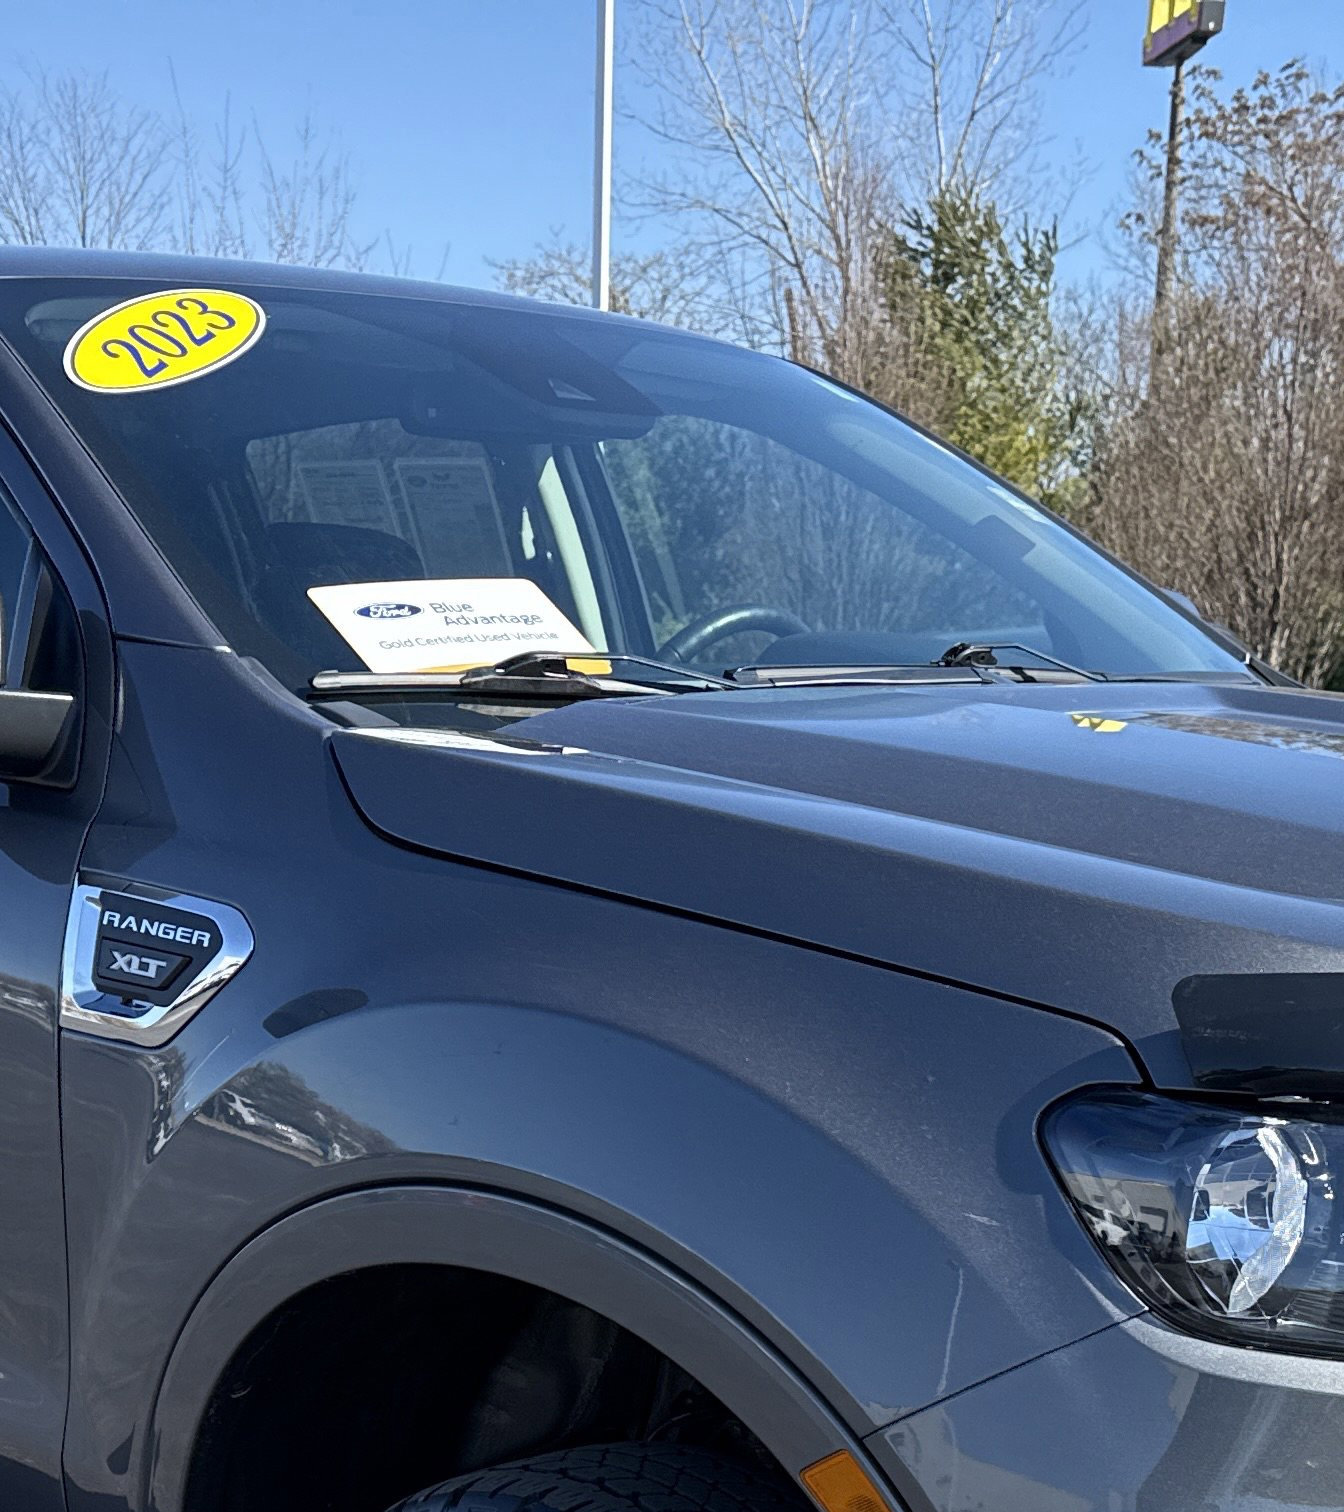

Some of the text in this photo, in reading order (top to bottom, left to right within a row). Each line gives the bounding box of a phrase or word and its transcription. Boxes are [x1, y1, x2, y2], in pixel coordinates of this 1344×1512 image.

[101, 297, 236, 378] 2023
[368, 602, 413, 619] Ford
[429, 601, 474, 614] Blue
[443, 612, 544, 627] Advantage
[378, 630, 559, 650] Gold Certified Used Vehicle
[103, 910, 211, 948] RANGER
[109, 950, 167, 979] XLT
